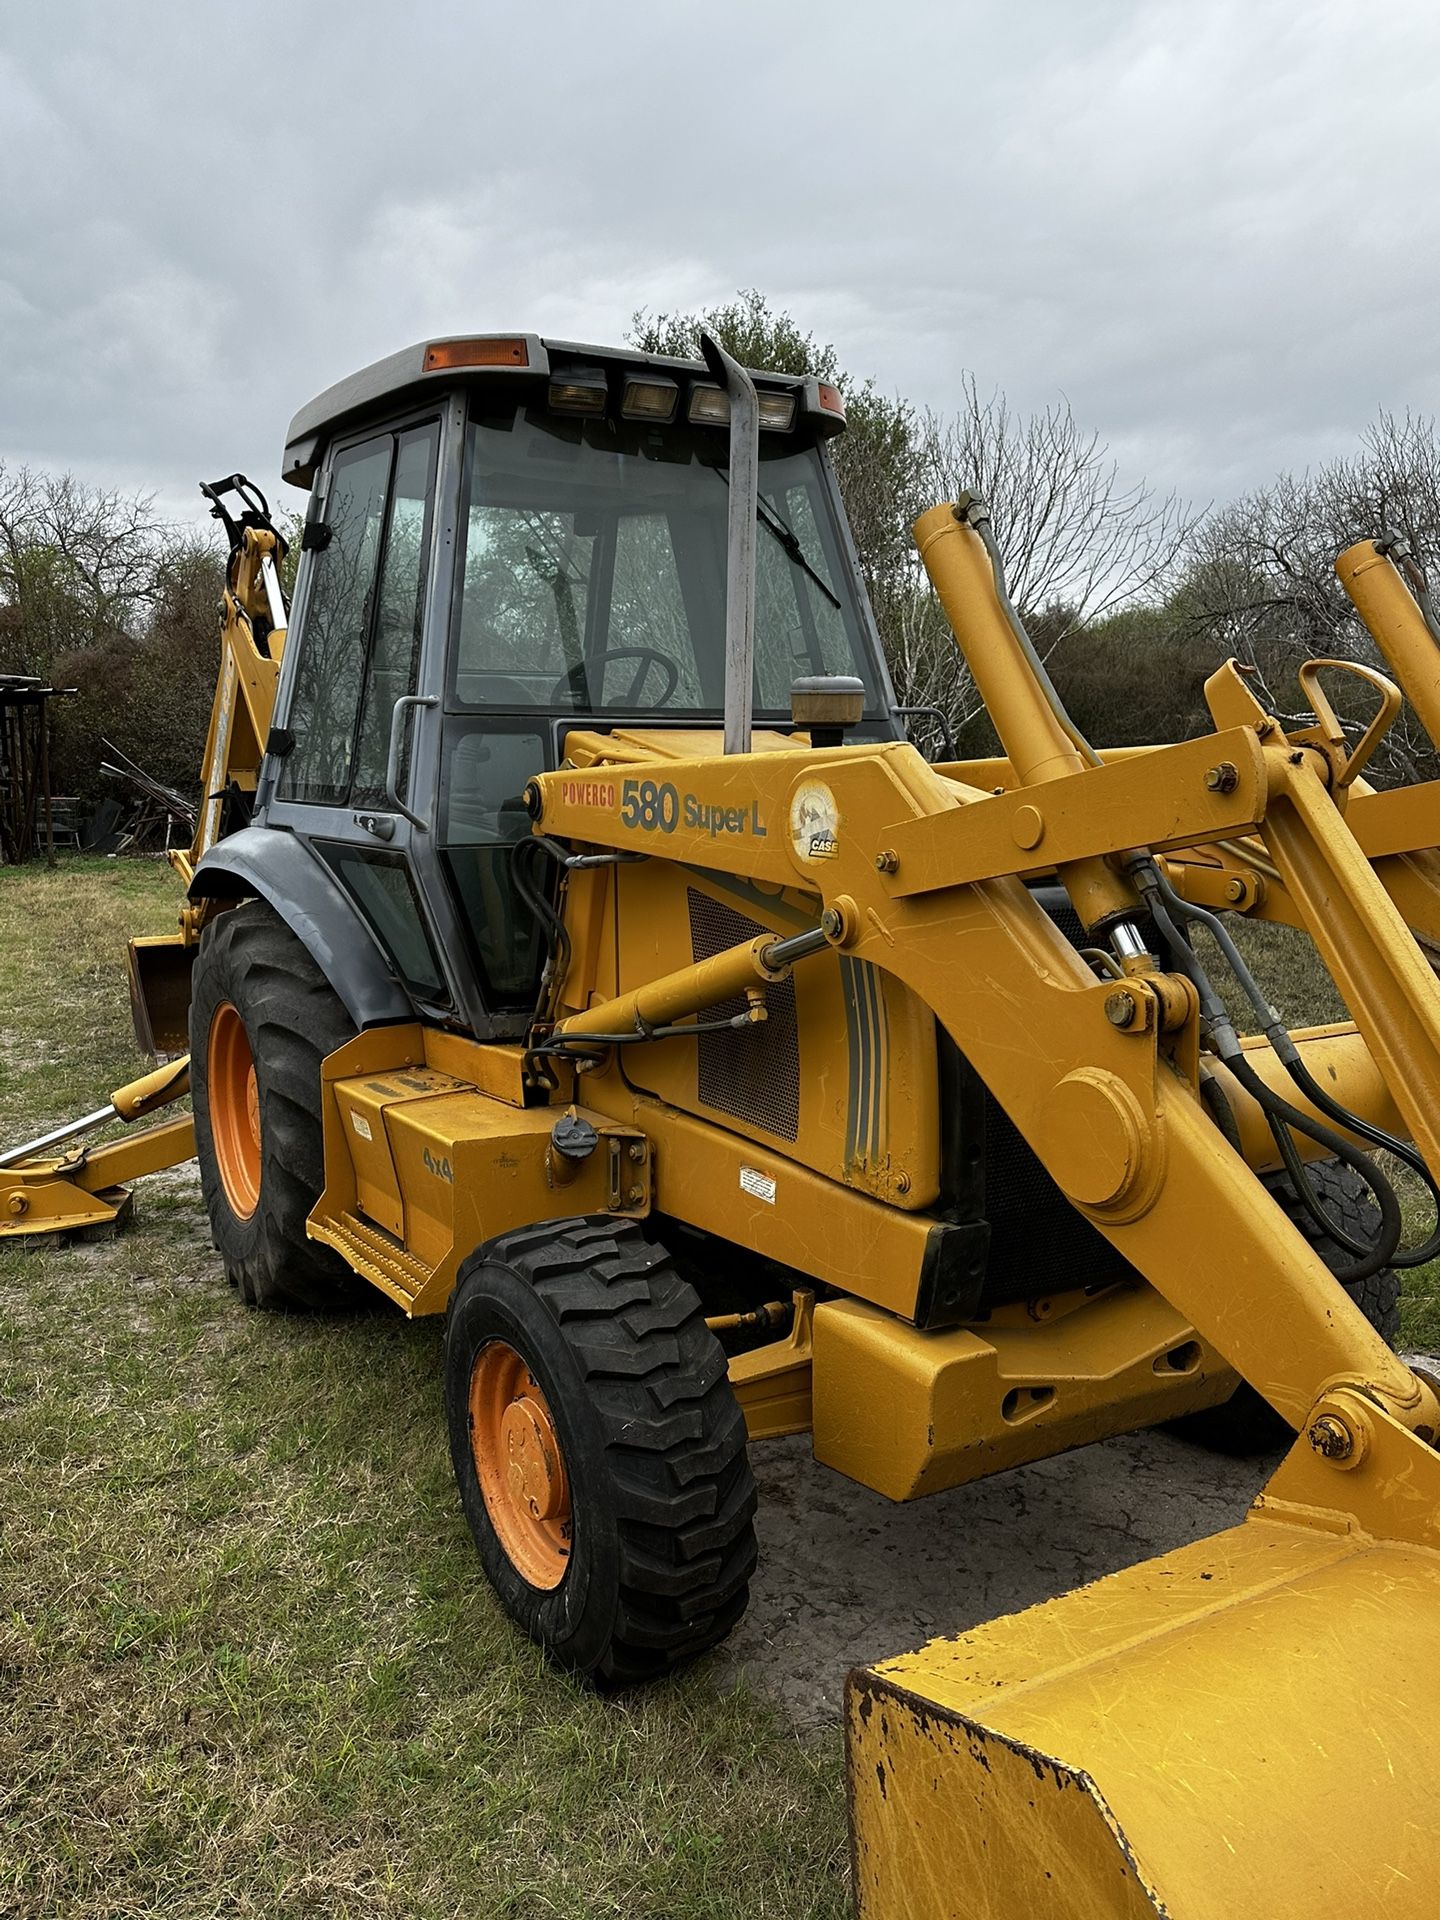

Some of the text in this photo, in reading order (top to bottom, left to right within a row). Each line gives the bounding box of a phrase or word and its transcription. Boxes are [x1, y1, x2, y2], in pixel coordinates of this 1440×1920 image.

[562, 782, 614, 807] POWERCO
[621, 779, 679, 833] 580
[684, 794, 748, 837] Super
[752, 800, 767, 836] L
[811, 839, 839, 853] CASE
[423, 1147, 453, 1184] 4x4
